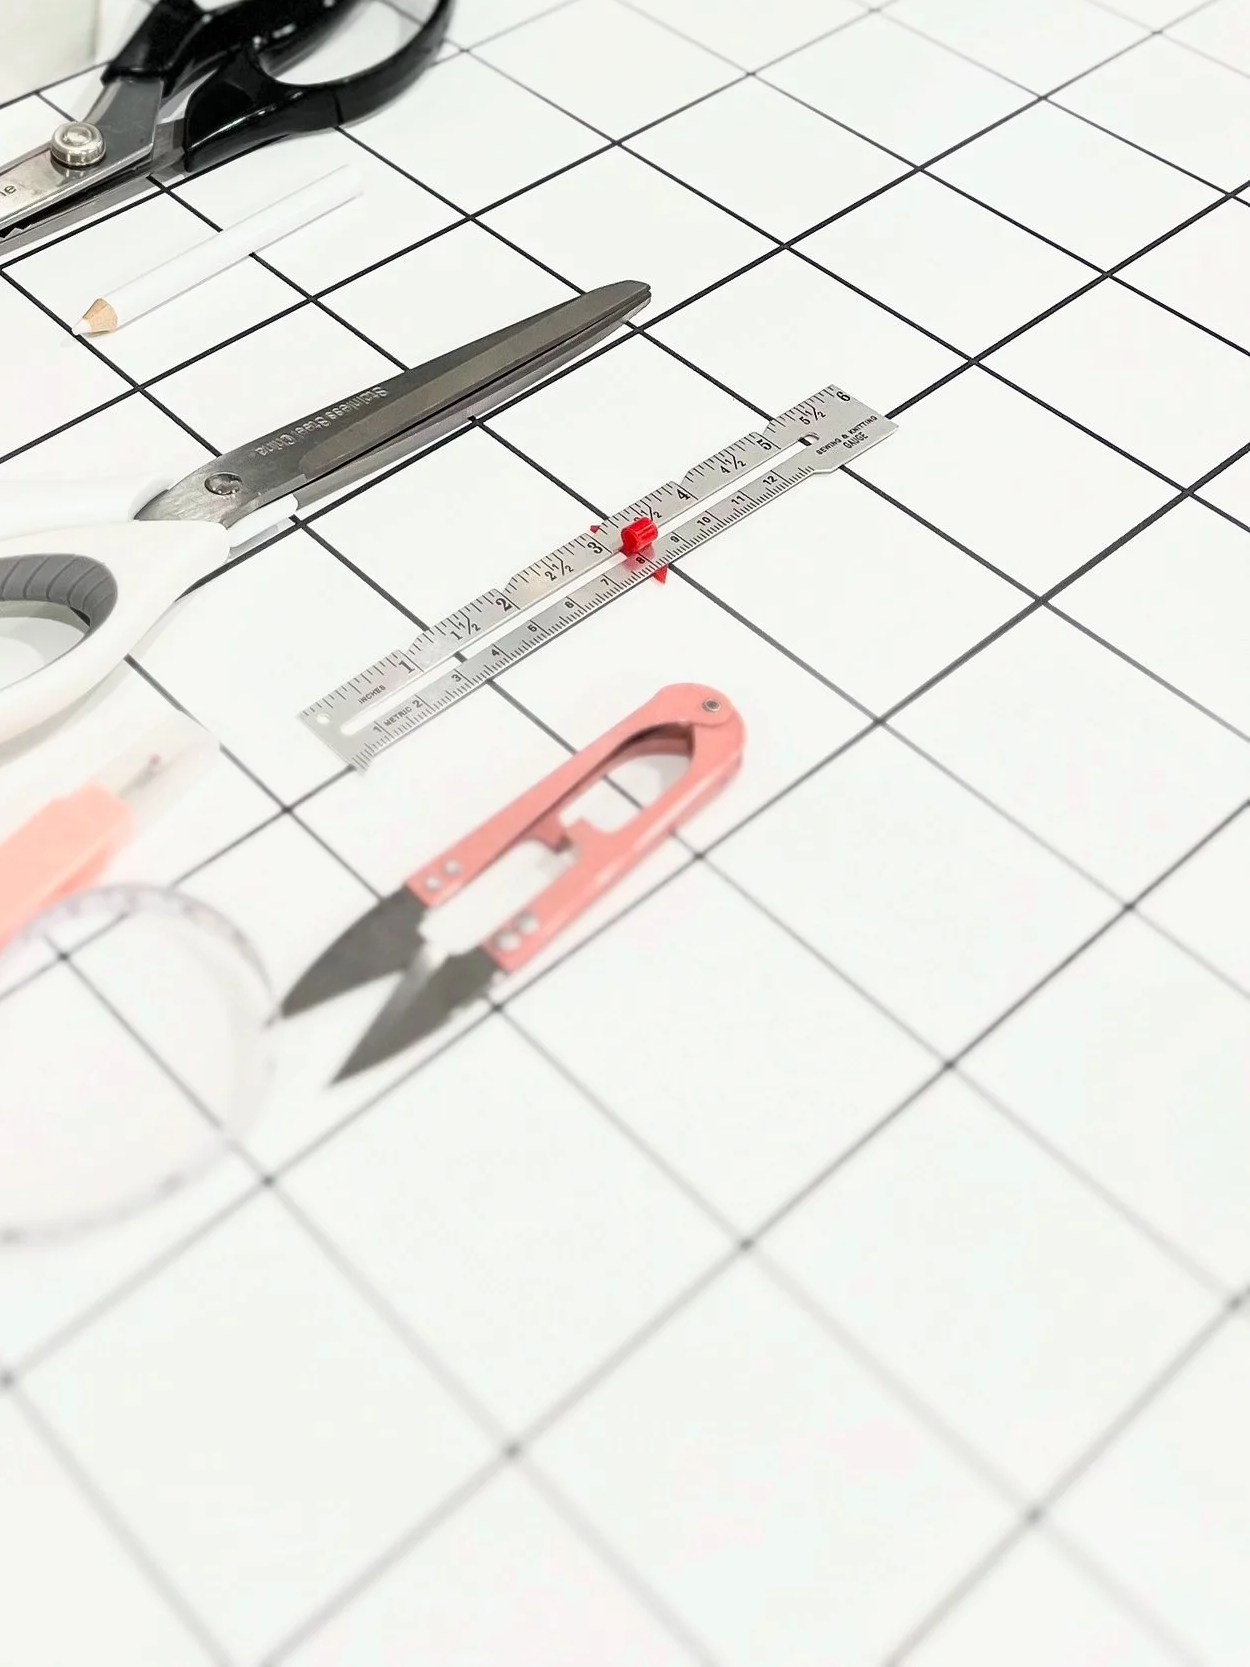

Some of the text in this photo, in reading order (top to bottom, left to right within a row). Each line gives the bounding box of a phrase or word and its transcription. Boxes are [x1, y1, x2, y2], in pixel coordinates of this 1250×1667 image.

[254, 385, 389, 456] Stainless Steel China
[815, 415, 878, 455] SEWING & KNITTING
[843, 432, 869, 449] GAUGE
[358, 684, 387, 705] INCHES
[398, 659, 416, 675] 1
[495, 596, 512, 612] 2
[586, 541, 604, 555] 3
[676, 488, 692, 502] 4
[756, 438, 773, 451] 5
[836, 390, 851, 403] 6
[372, 475, 778, 734] 1 METRIC 2 3 4 5 6 7 8 9 10 11 12
